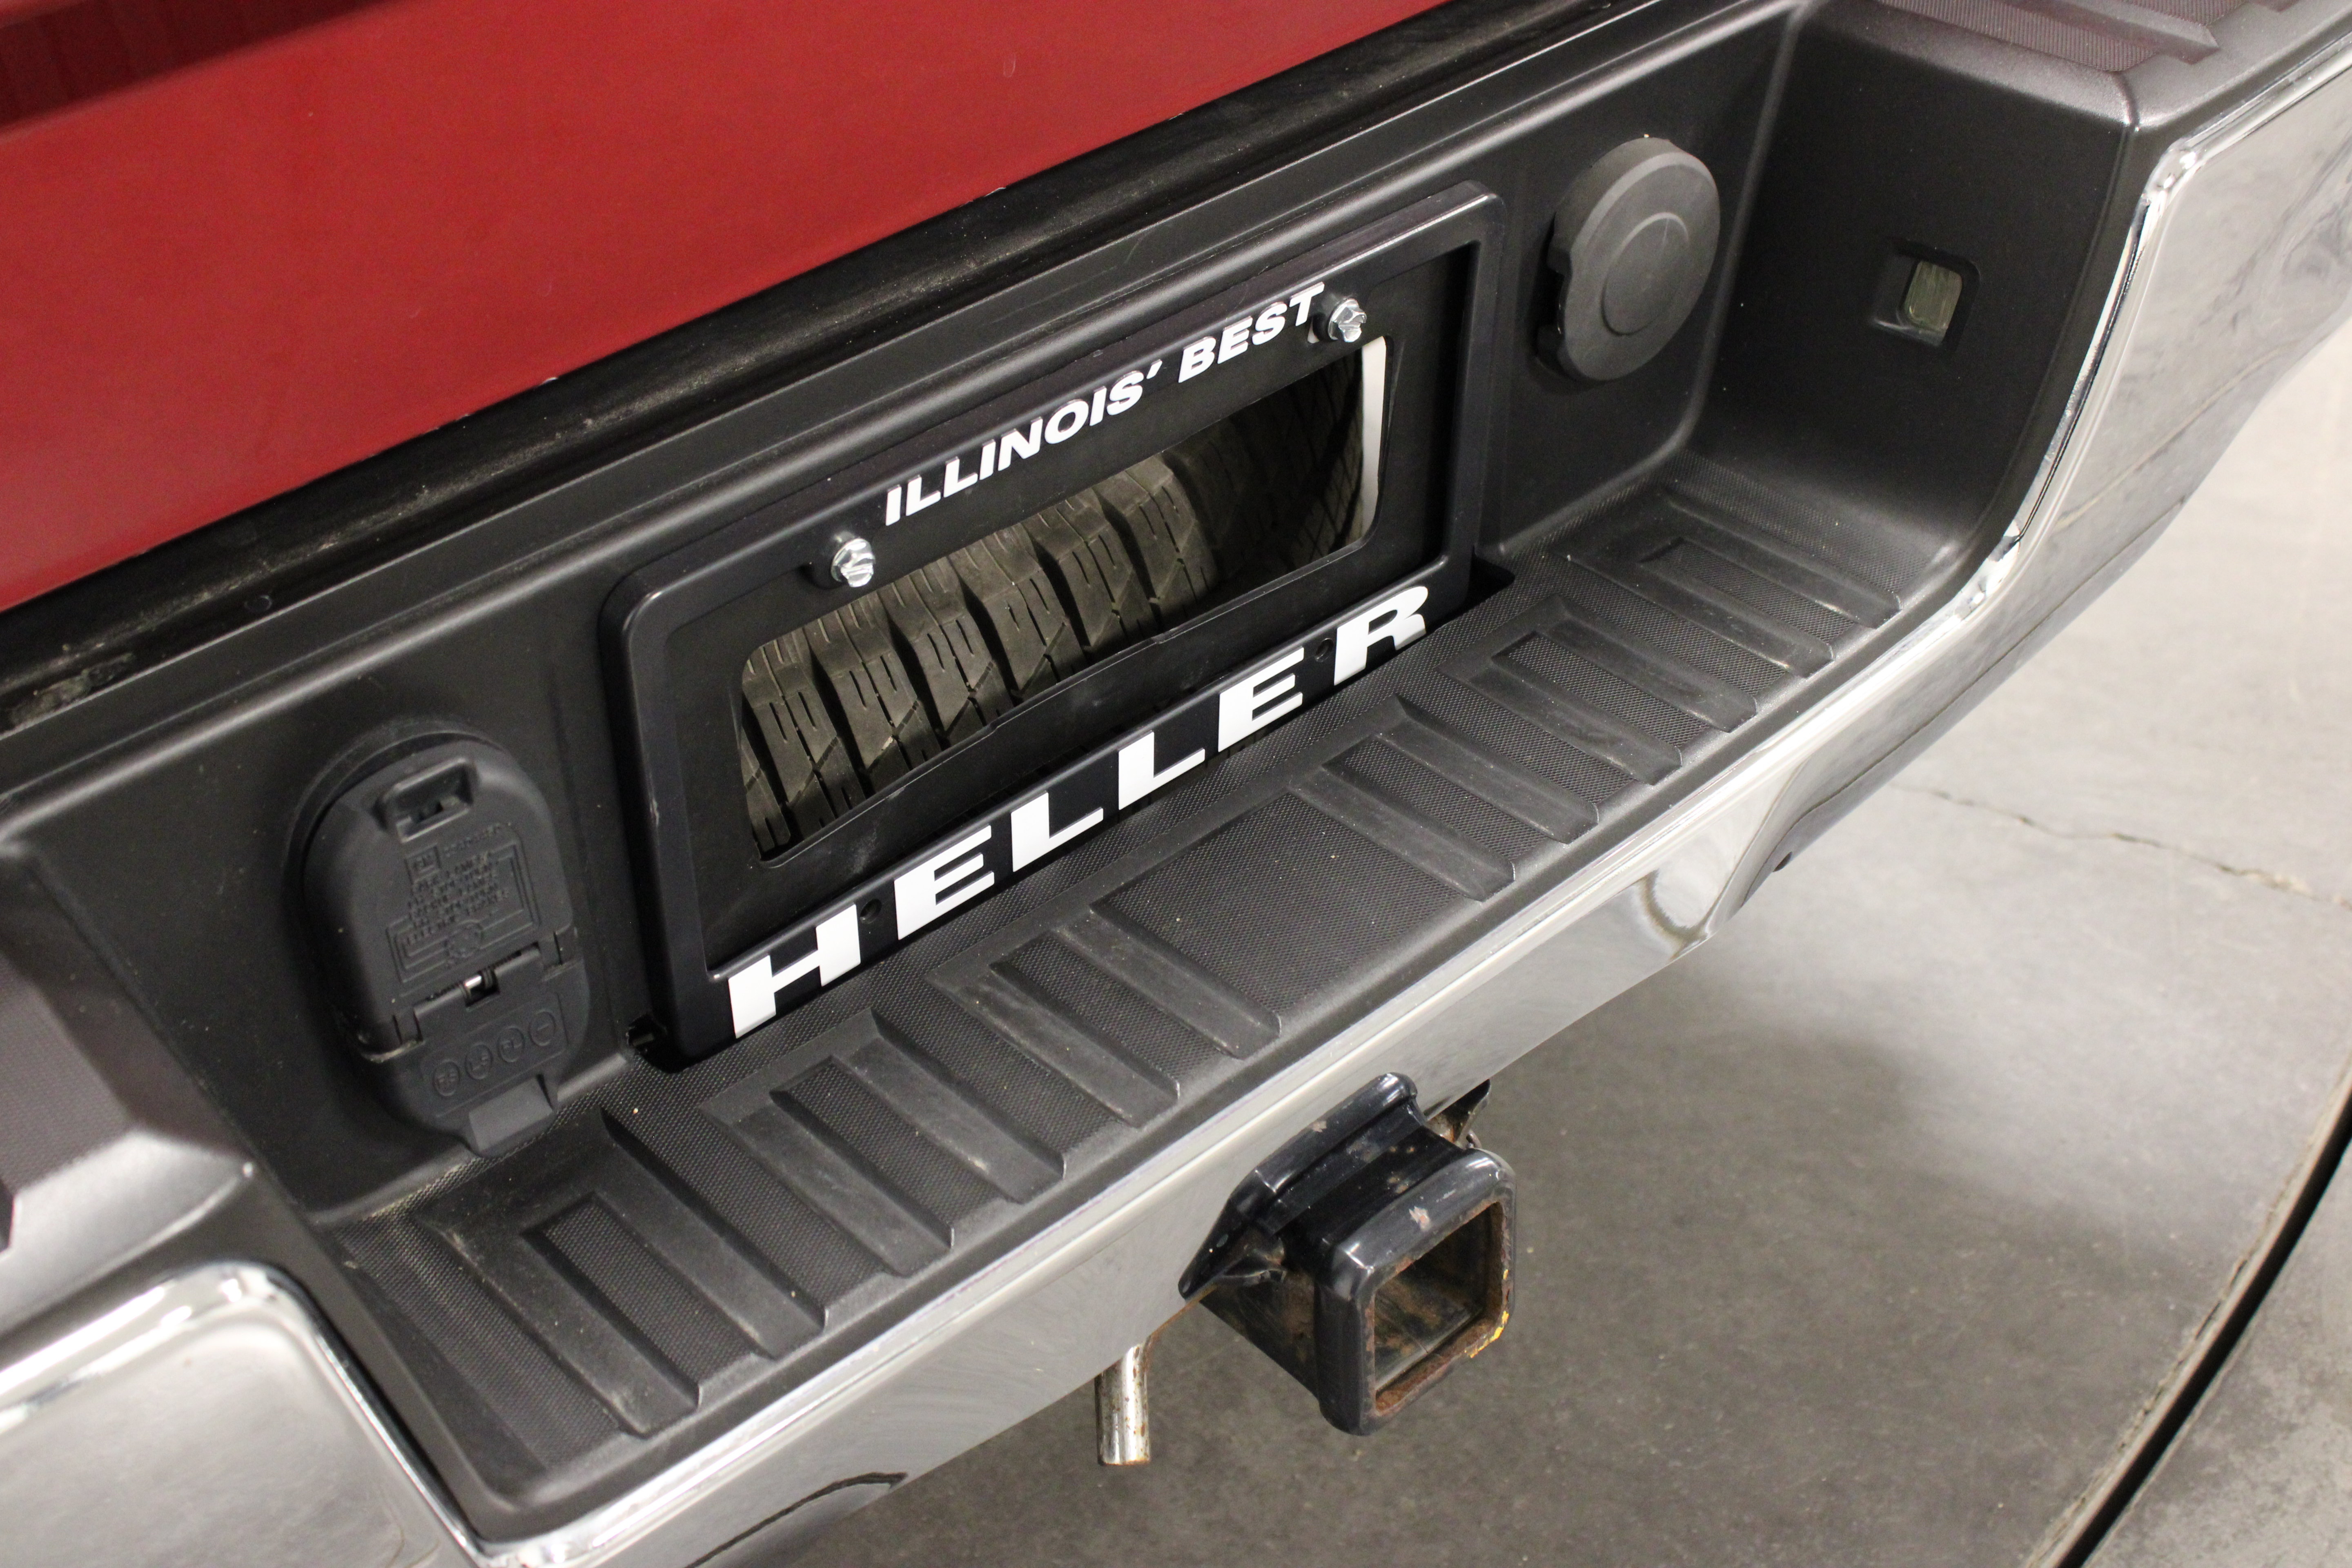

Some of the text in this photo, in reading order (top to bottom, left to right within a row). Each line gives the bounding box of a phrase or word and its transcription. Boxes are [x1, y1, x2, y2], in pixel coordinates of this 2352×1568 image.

[885, 281, 1325, 526] ILLINOIS' BEST
[728, 586, 1428, 1038] HELLER
